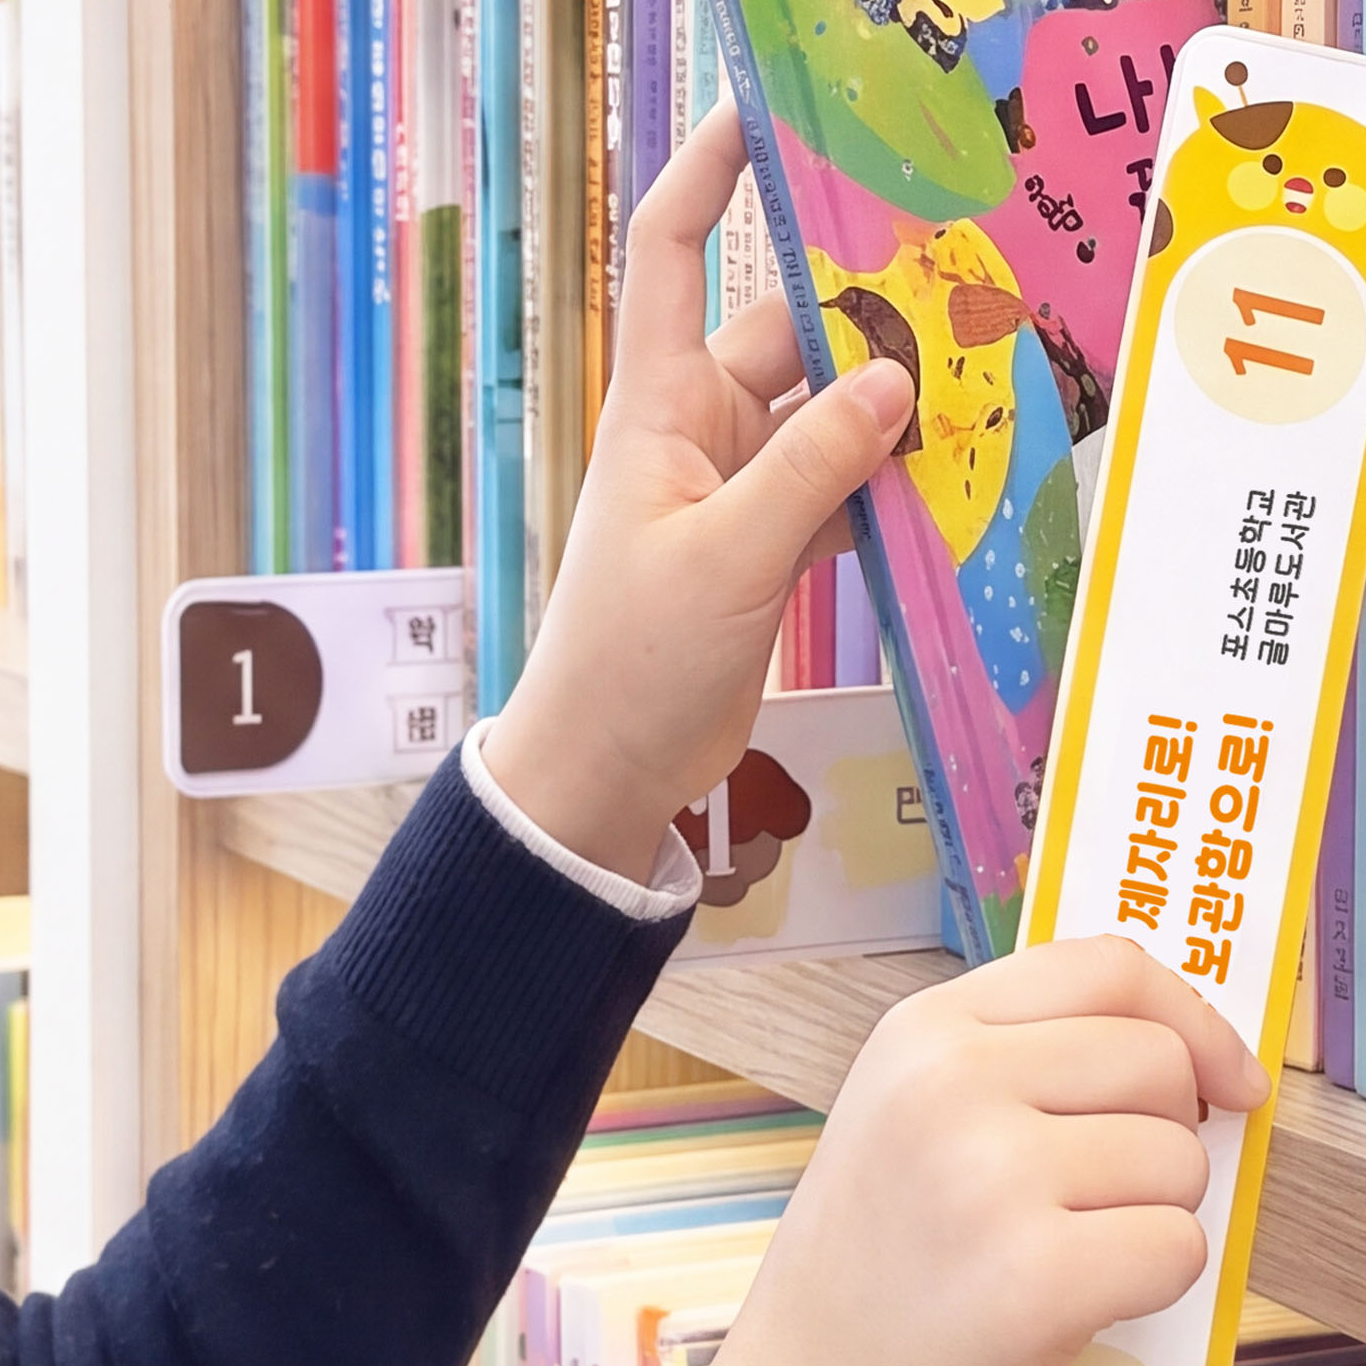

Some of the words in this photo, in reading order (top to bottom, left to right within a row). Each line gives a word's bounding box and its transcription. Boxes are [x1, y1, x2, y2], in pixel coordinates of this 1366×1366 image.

[1222, 287, 1326, 377] 11
[1221, 489, 1275, 661] 포스초등학교
[1257, 490, 1316, 665] 글마루도서관
[230, 649, 264, 727] 1
[1117, 714, 1198, 931] 제자리로!
[1181, 713, 1274, 985] 보관함으로!
